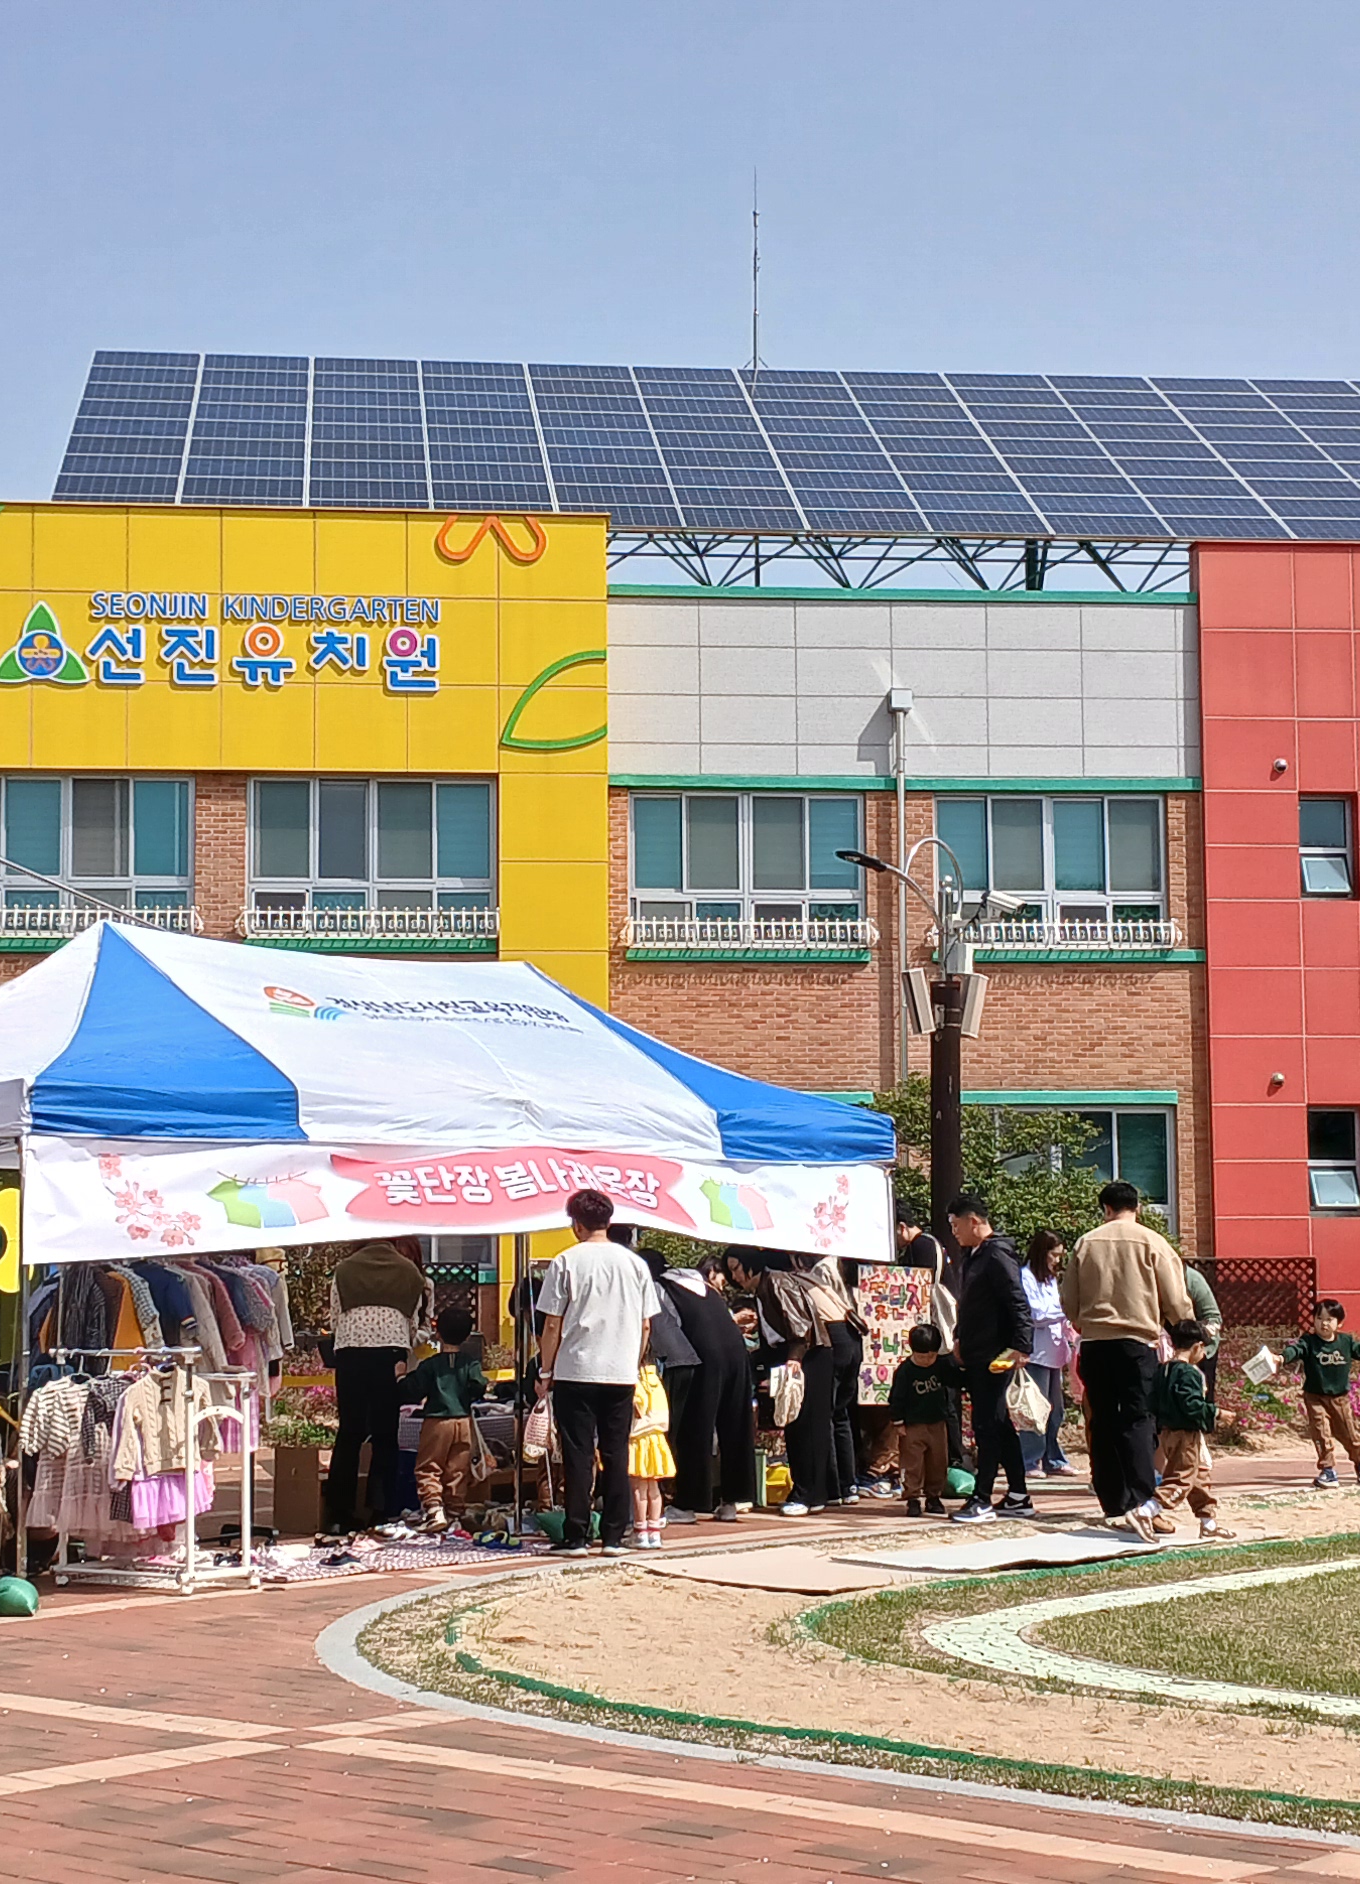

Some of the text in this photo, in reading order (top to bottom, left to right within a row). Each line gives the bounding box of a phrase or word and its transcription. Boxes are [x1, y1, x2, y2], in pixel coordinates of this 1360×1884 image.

[90, 592, 441, 623] SEONJIN KINDERGARTEN
[86, 622, 441, 692] 선진유치원
[373, 1163, 494, 1205] 꽃단장
